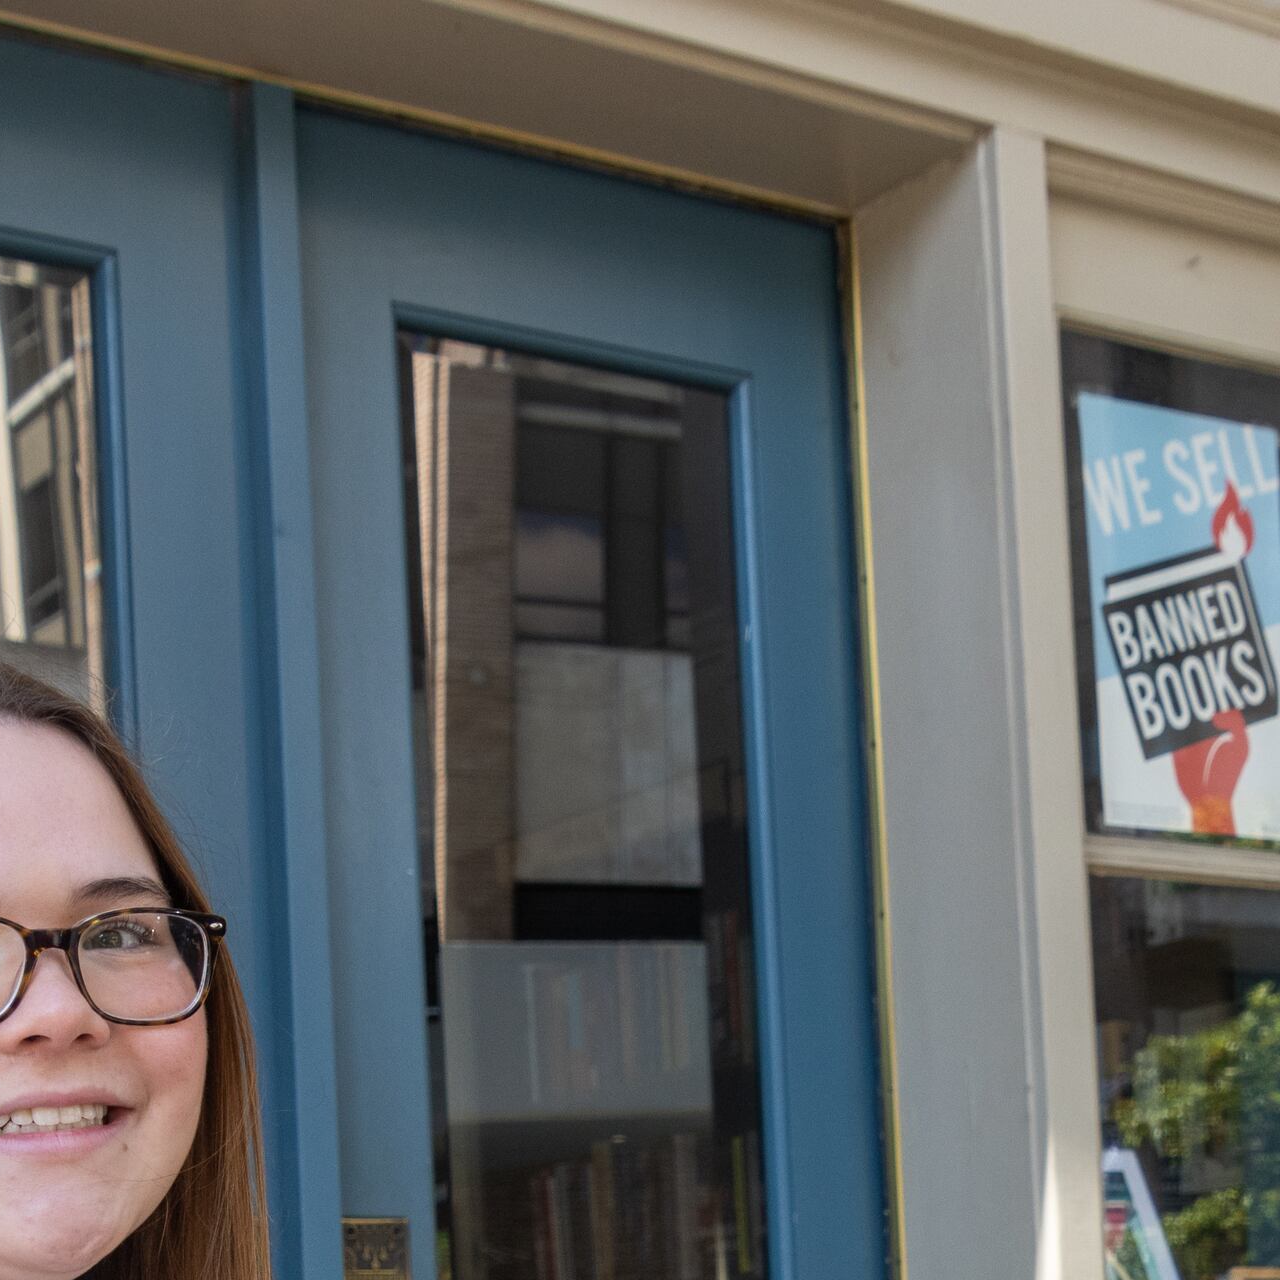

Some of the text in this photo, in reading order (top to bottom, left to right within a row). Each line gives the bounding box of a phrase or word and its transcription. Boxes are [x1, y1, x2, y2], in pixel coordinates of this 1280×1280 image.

[1083, 423, 1280, 537] WE SELL
[1107, 579, 1247, 670] BANNED
[1125, 639, 1268, 741] BOOKS
